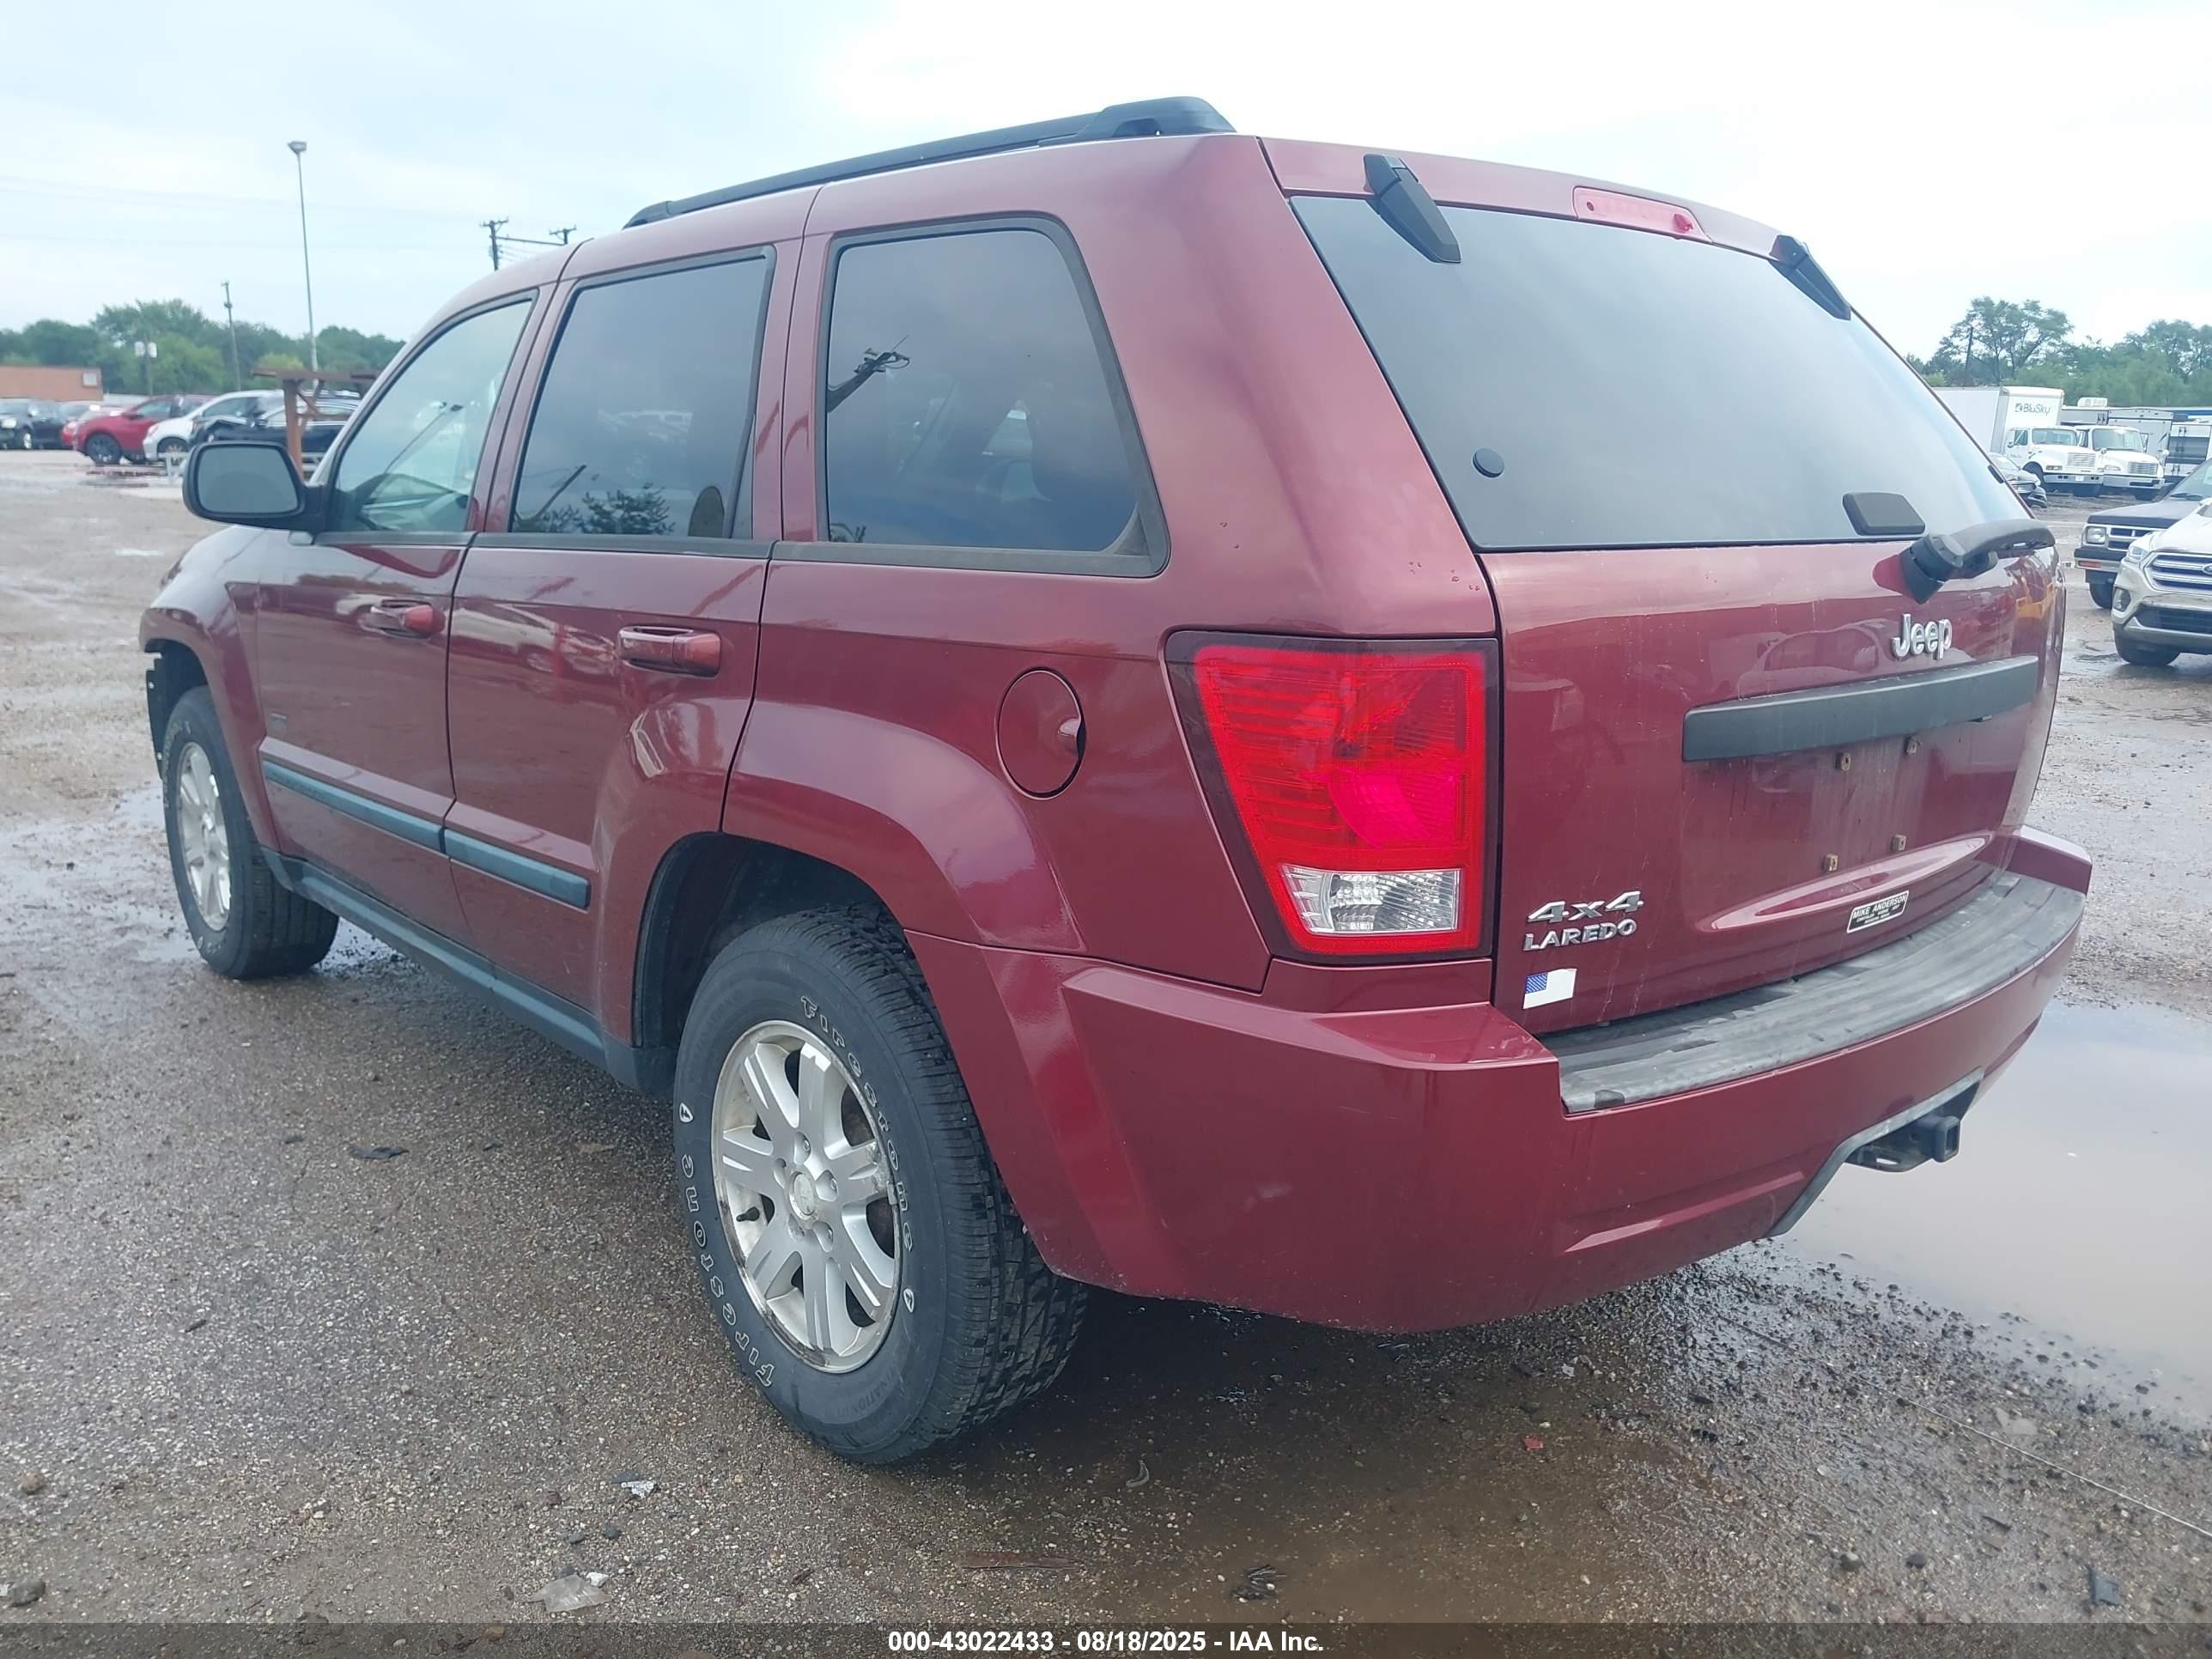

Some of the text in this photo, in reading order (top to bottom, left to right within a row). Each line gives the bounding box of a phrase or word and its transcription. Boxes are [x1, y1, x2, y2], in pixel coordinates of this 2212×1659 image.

[2023, 403, 2051, 416] BluSky
[1892, 613, 1953, 660] Jeep
[1528, 890, 1644, 923] 4x4
[1852, 907, 1871, 920] MIKE
[1872, 894, 1908, 913] ANDERSON
[1523, 918, 1638, 951] LAREDO
[800, 995, 914, 1251] Firestone
[682, 1152, 775, 1388] Firestone
